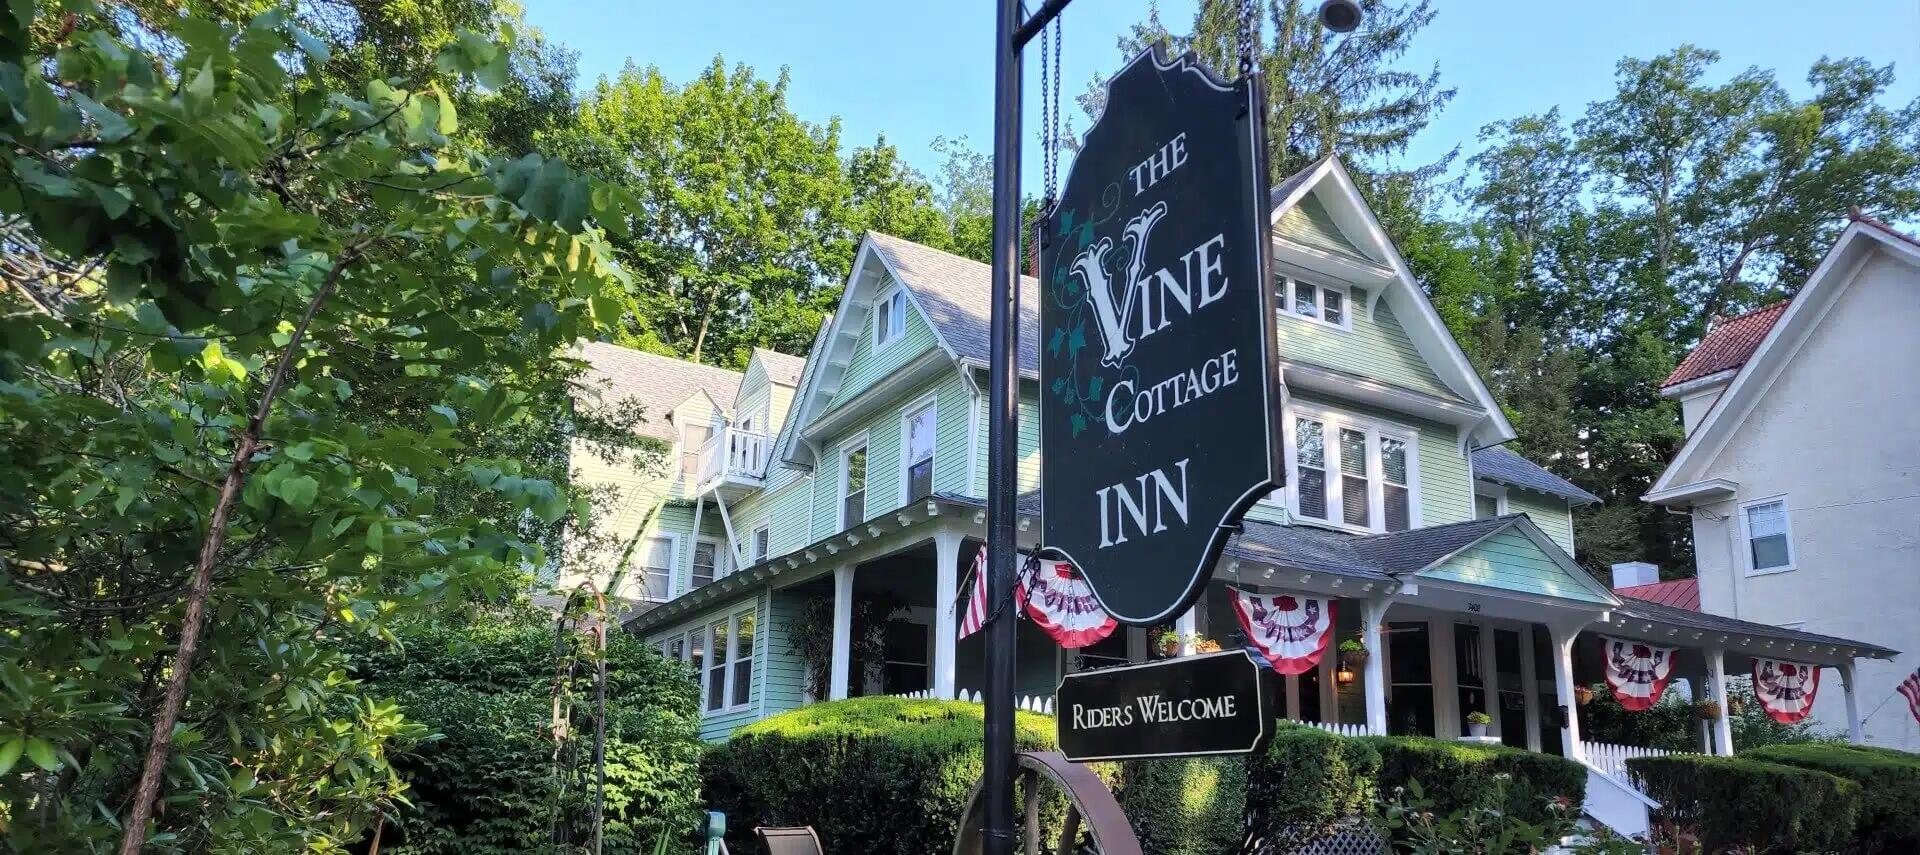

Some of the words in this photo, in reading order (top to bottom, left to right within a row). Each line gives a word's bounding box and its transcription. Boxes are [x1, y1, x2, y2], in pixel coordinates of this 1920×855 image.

[1129, 132, 1189, 197] THE
[1070, 201, 1229, 368] VINE
[1104, 349, 1240, 434] COTTAGE
[1096, 458, 1190, 549] INN
[1072, 704, 1133, 730] RIDERS
[1137, 694, 1237, 724] WELCOME
